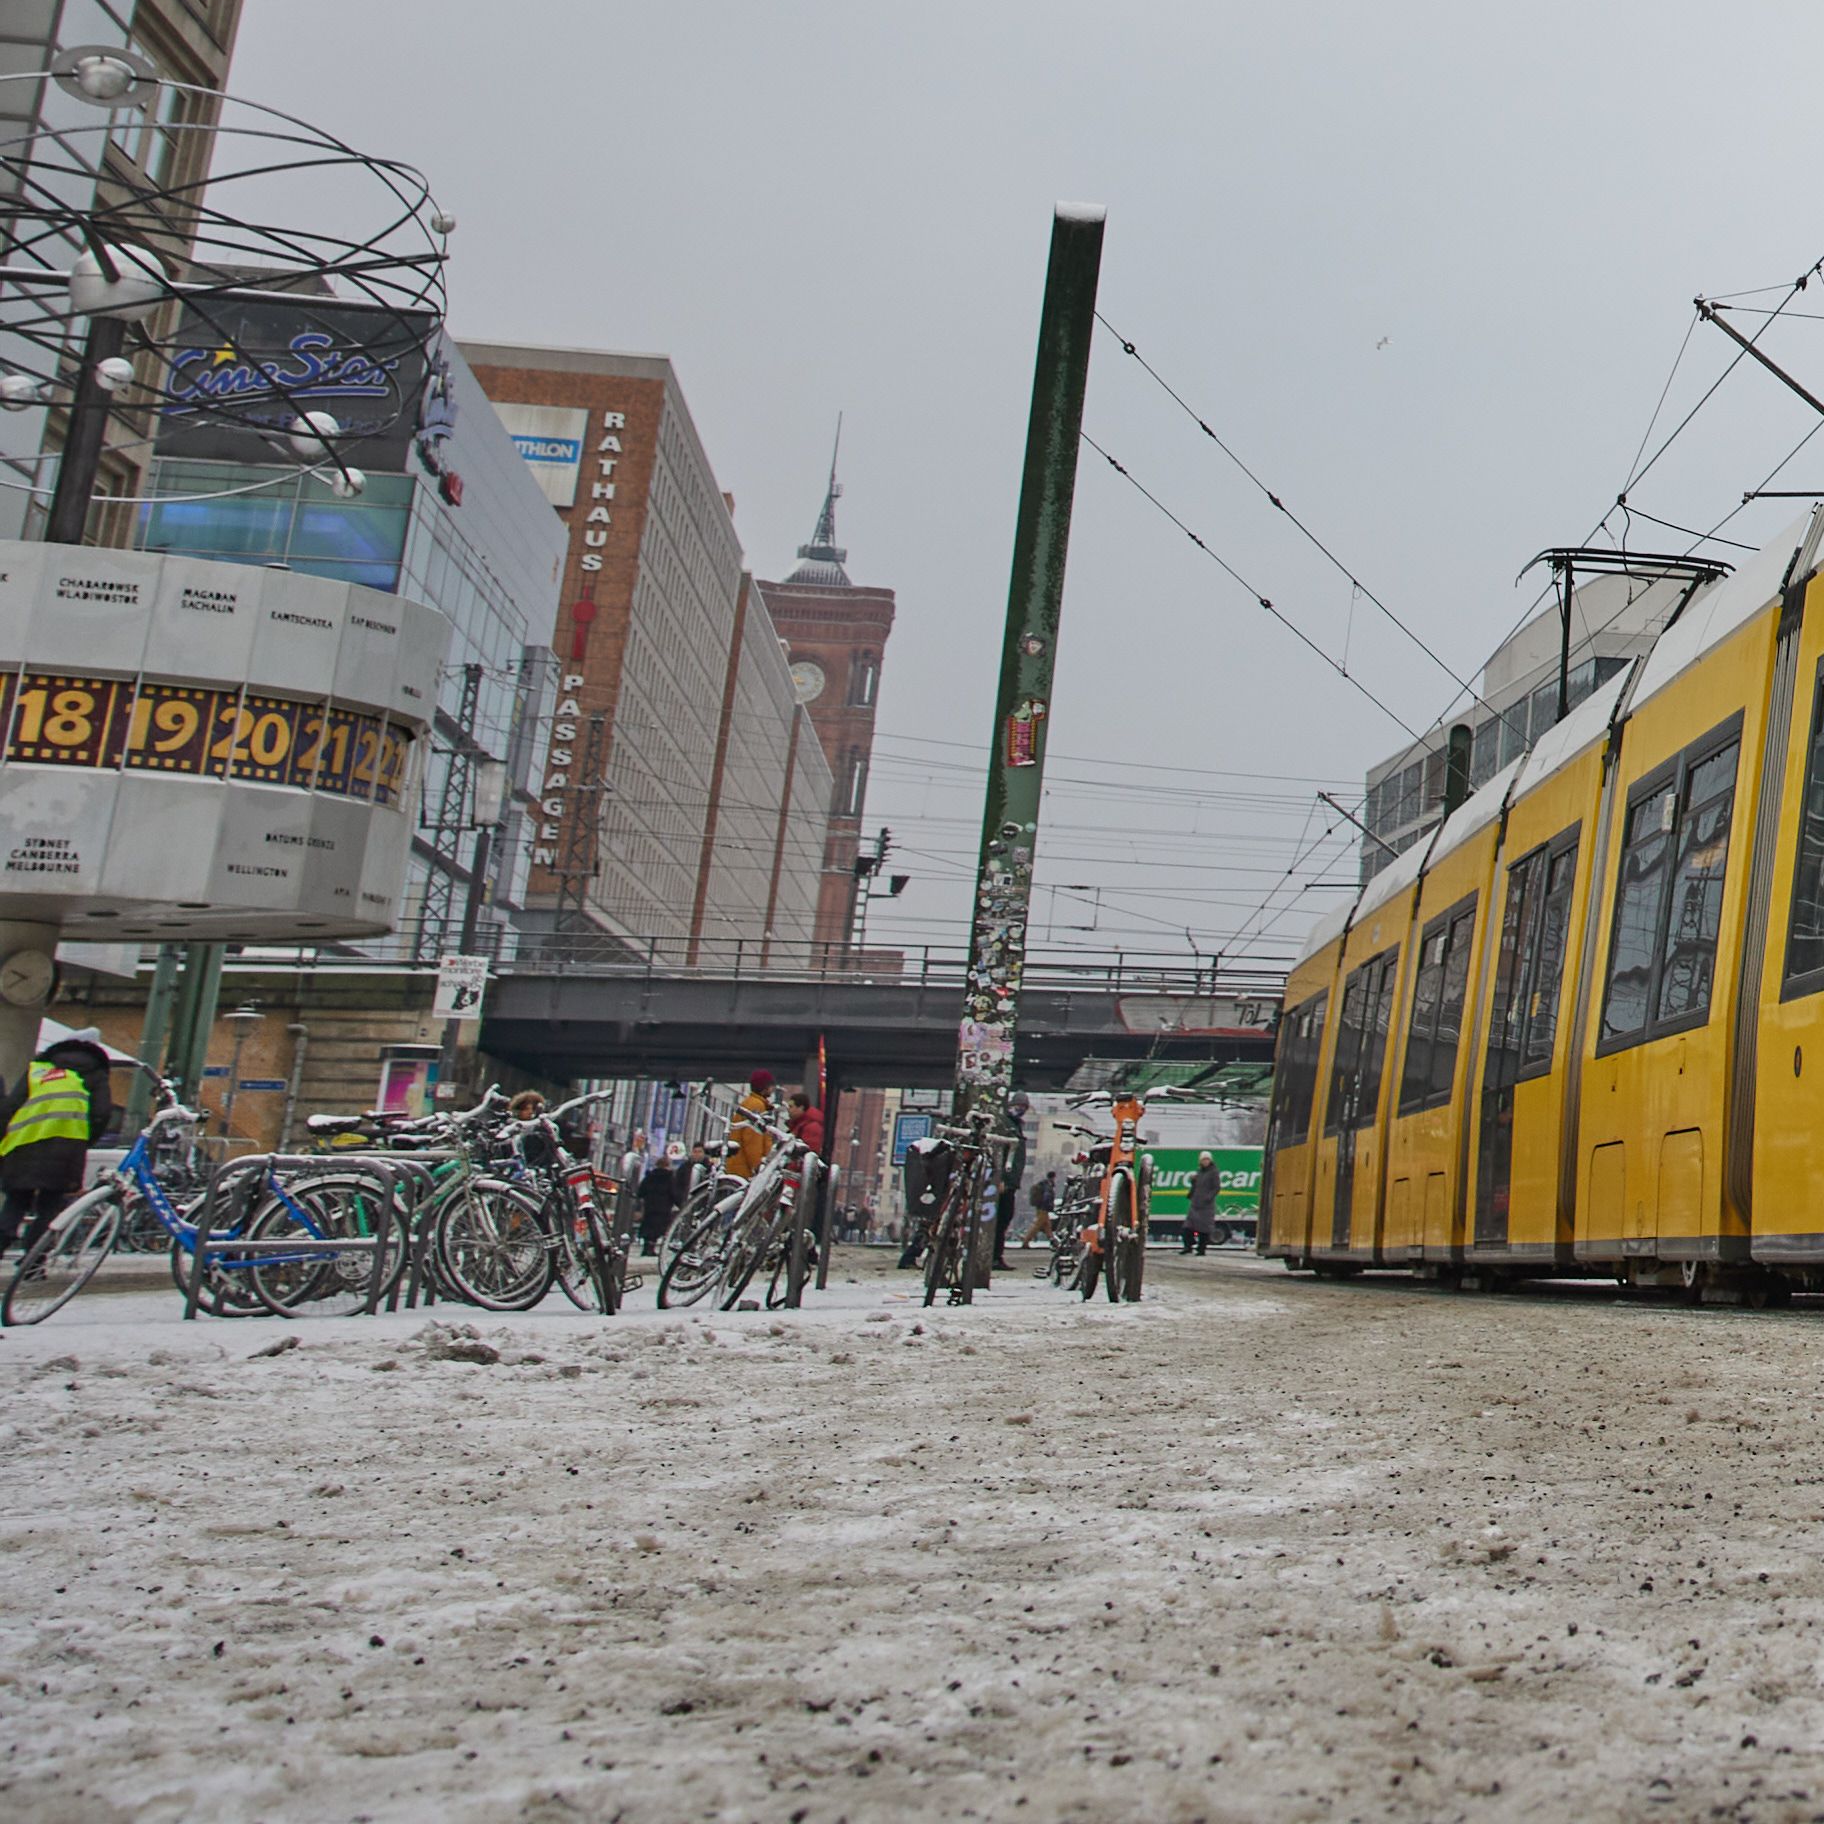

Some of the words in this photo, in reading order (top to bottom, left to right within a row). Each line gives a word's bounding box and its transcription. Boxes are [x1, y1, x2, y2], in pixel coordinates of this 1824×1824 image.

[516, 440, 574, 459] THLON
[581, 411, 626, 571] RATHAUS
[184, 588, 236, 602] MAGADAN
[181, 599, 235, 614] SACHALIN
[17, 688, 95, 746] 18
[125, 697, 199, 753] 19
[211, 706, 291, 766] 20
[297, 719, 350, 775] 21
[533, 675, 584, 865] PASSAGEN
[25, 837, 71, 849] SYDNEY
[10, 849, 80, 861] CANBERRA
[5, 860, 80, 873] MELBOURNE
[227, 864, 288, 877] WELLINGTON
[1151, 1165, 1261, 1188] urocar
